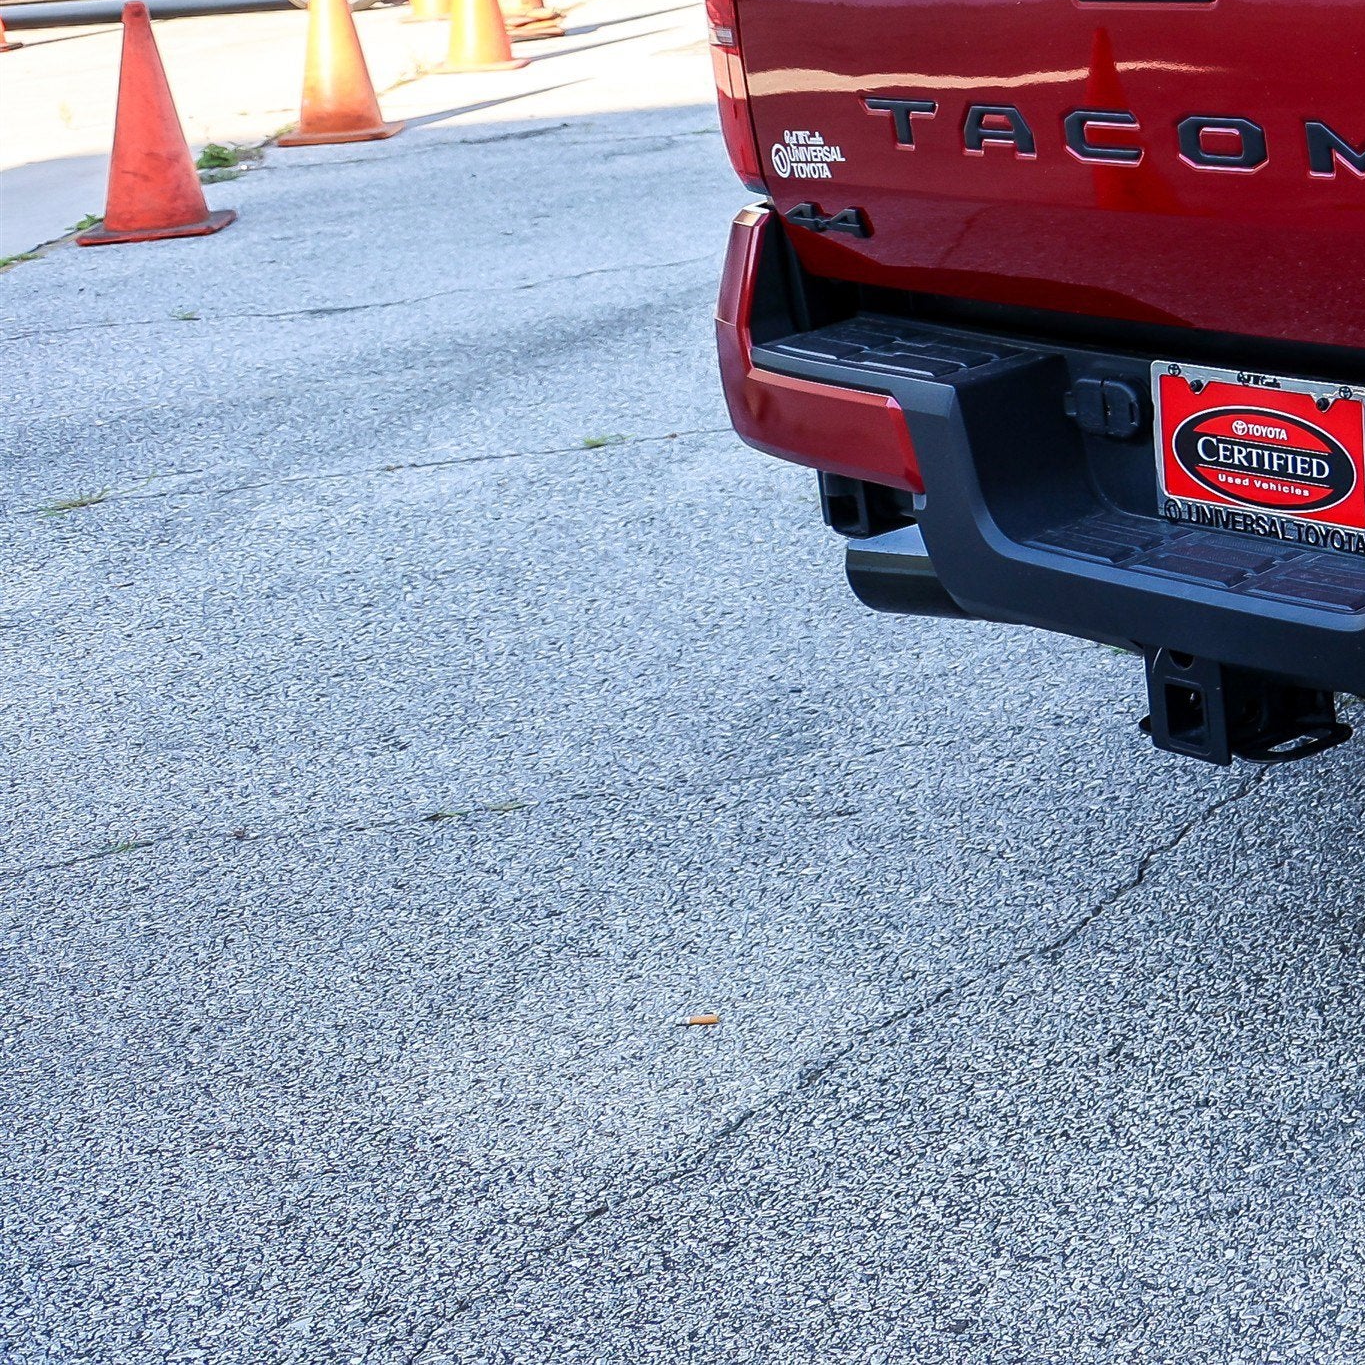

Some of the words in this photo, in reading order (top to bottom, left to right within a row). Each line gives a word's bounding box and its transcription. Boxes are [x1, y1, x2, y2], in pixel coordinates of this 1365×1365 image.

[787, 145, 846, 163] UNIVERSAL
[790, 162, 832, 179] TOYOTA
[1247, 423, 1288, 441] TOYOTA
[1197, 436, 1330, 479] CERTIFIED
[1217, 473, 1249, 486] Used
[1254, 480, 1310, 497] Vehicles
[1188, 500, 1293, 541] UNIVERSAL
